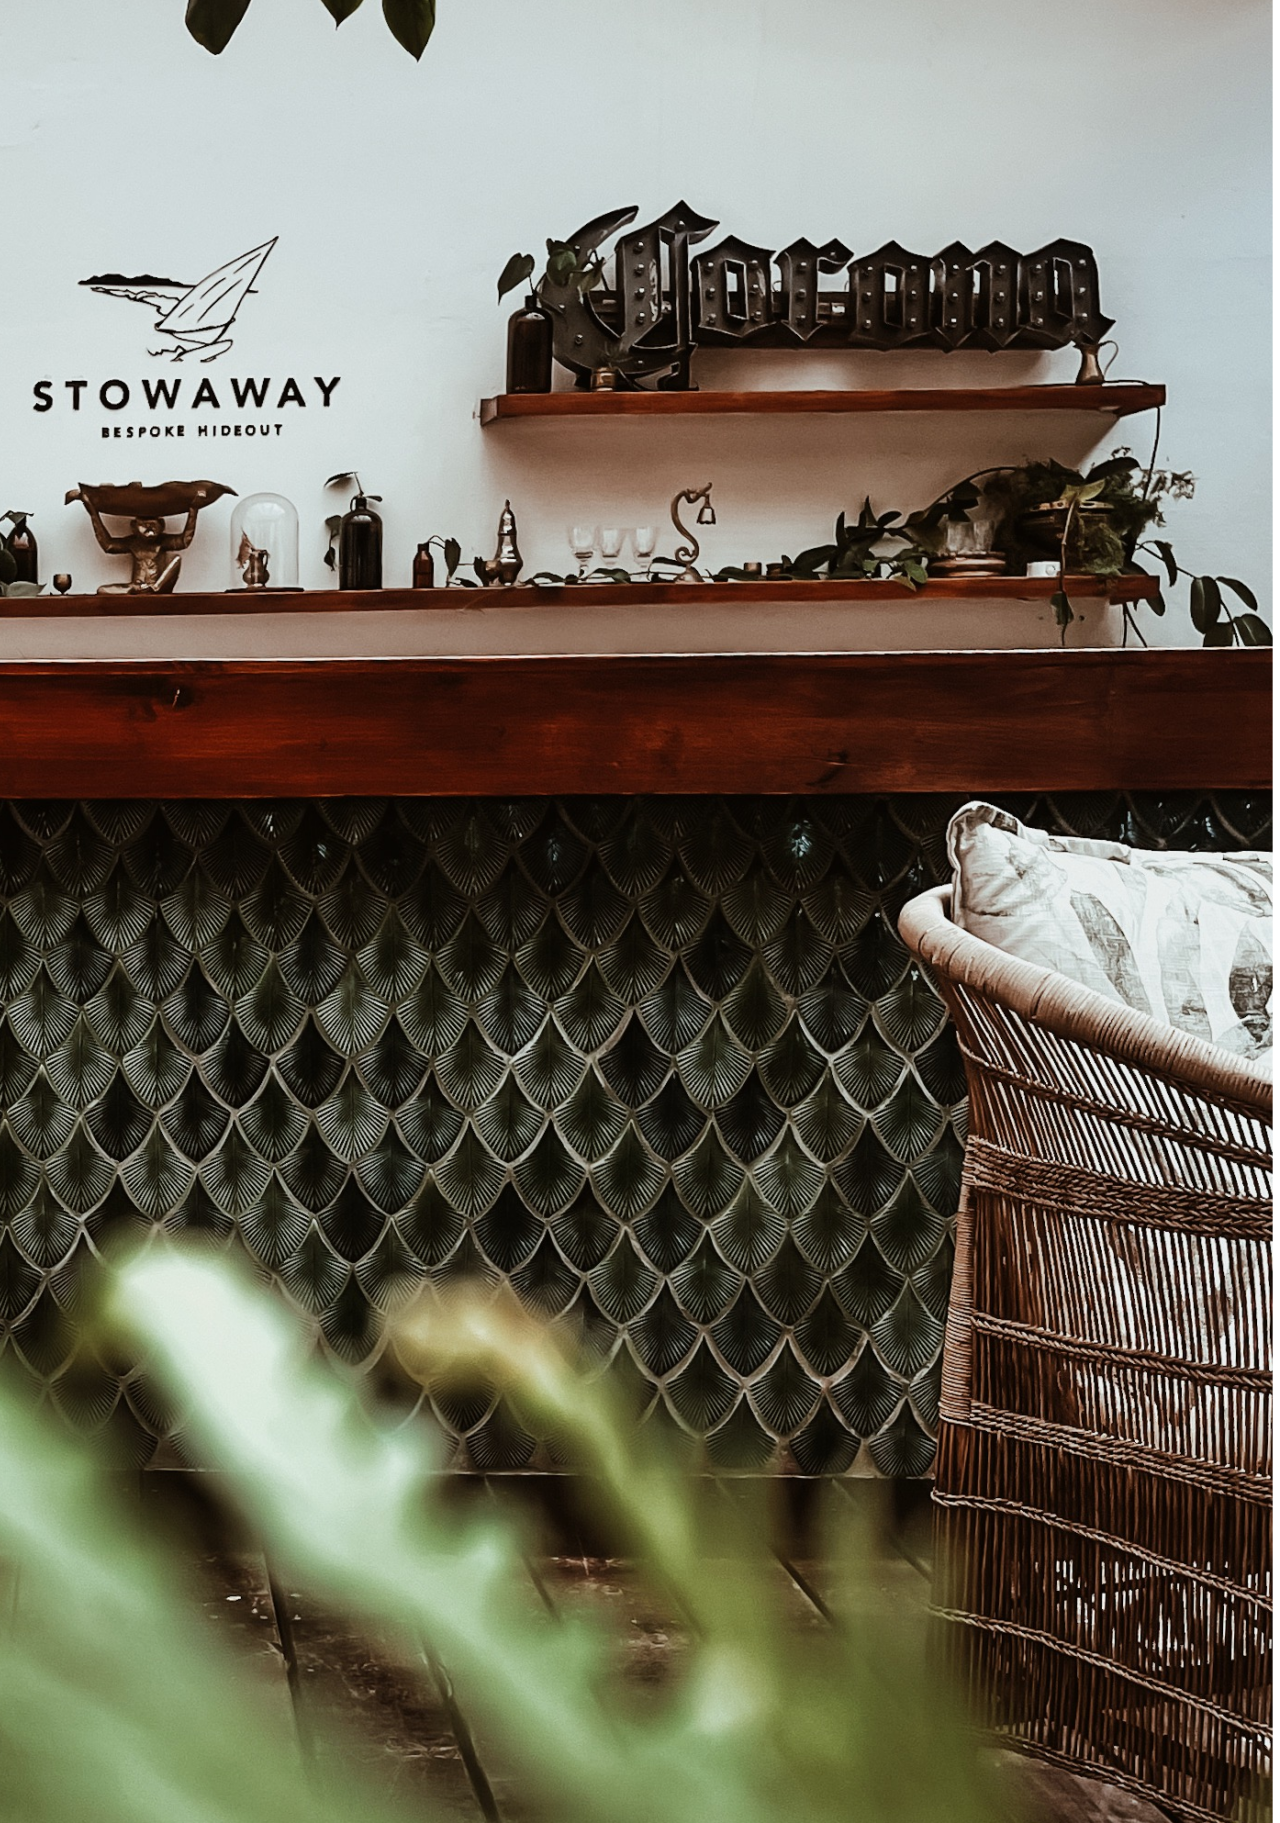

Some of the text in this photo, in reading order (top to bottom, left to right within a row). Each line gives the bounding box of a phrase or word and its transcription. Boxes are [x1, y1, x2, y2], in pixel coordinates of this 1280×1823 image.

[544, 201, 1116, 391] Corona
[32, 376, 341, 412] STOWAWAY
[101, 423, 283, 438] BESPOKE HIDEOUT
